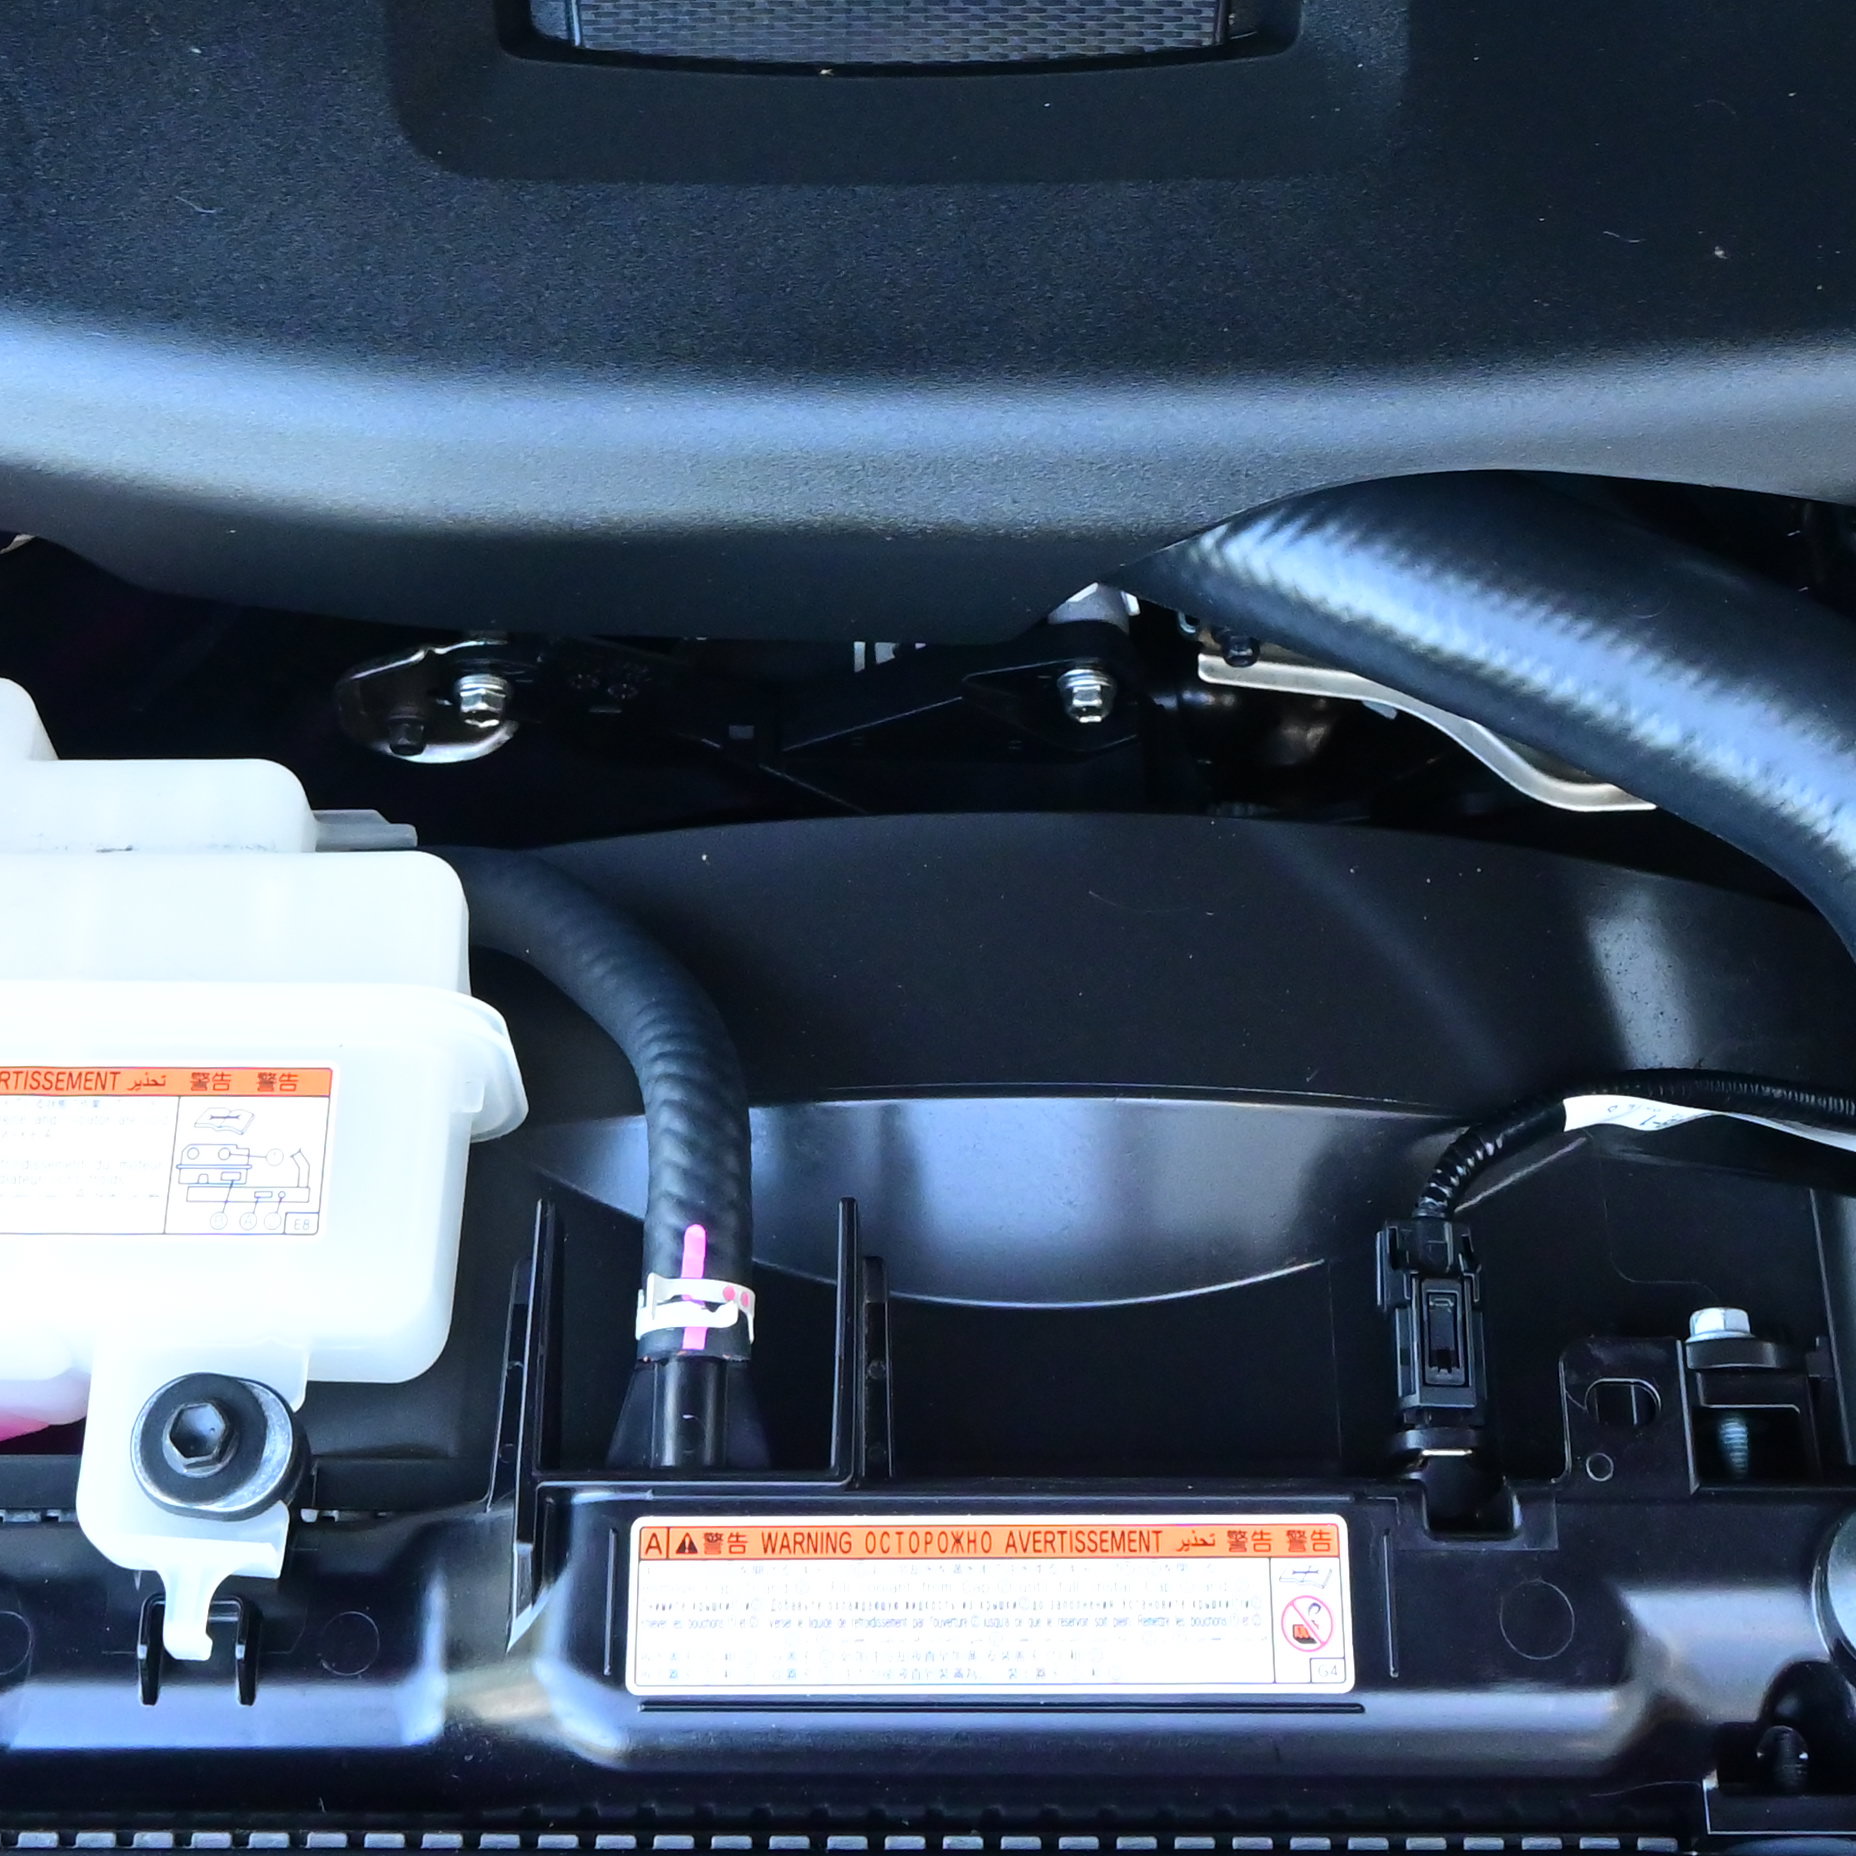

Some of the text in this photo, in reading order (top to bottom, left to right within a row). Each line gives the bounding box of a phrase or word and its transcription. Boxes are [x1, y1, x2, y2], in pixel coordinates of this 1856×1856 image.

[644, 1531, 663, 1555] A
[703, 1531, 747, 1554] 警告
[761, 1531, 853, 1555] WARNING
[865, 1530, 993, 1554] ОСТОРОЖНО
[1005, 1530, 1163, 1554] AVERTISSEMENT
